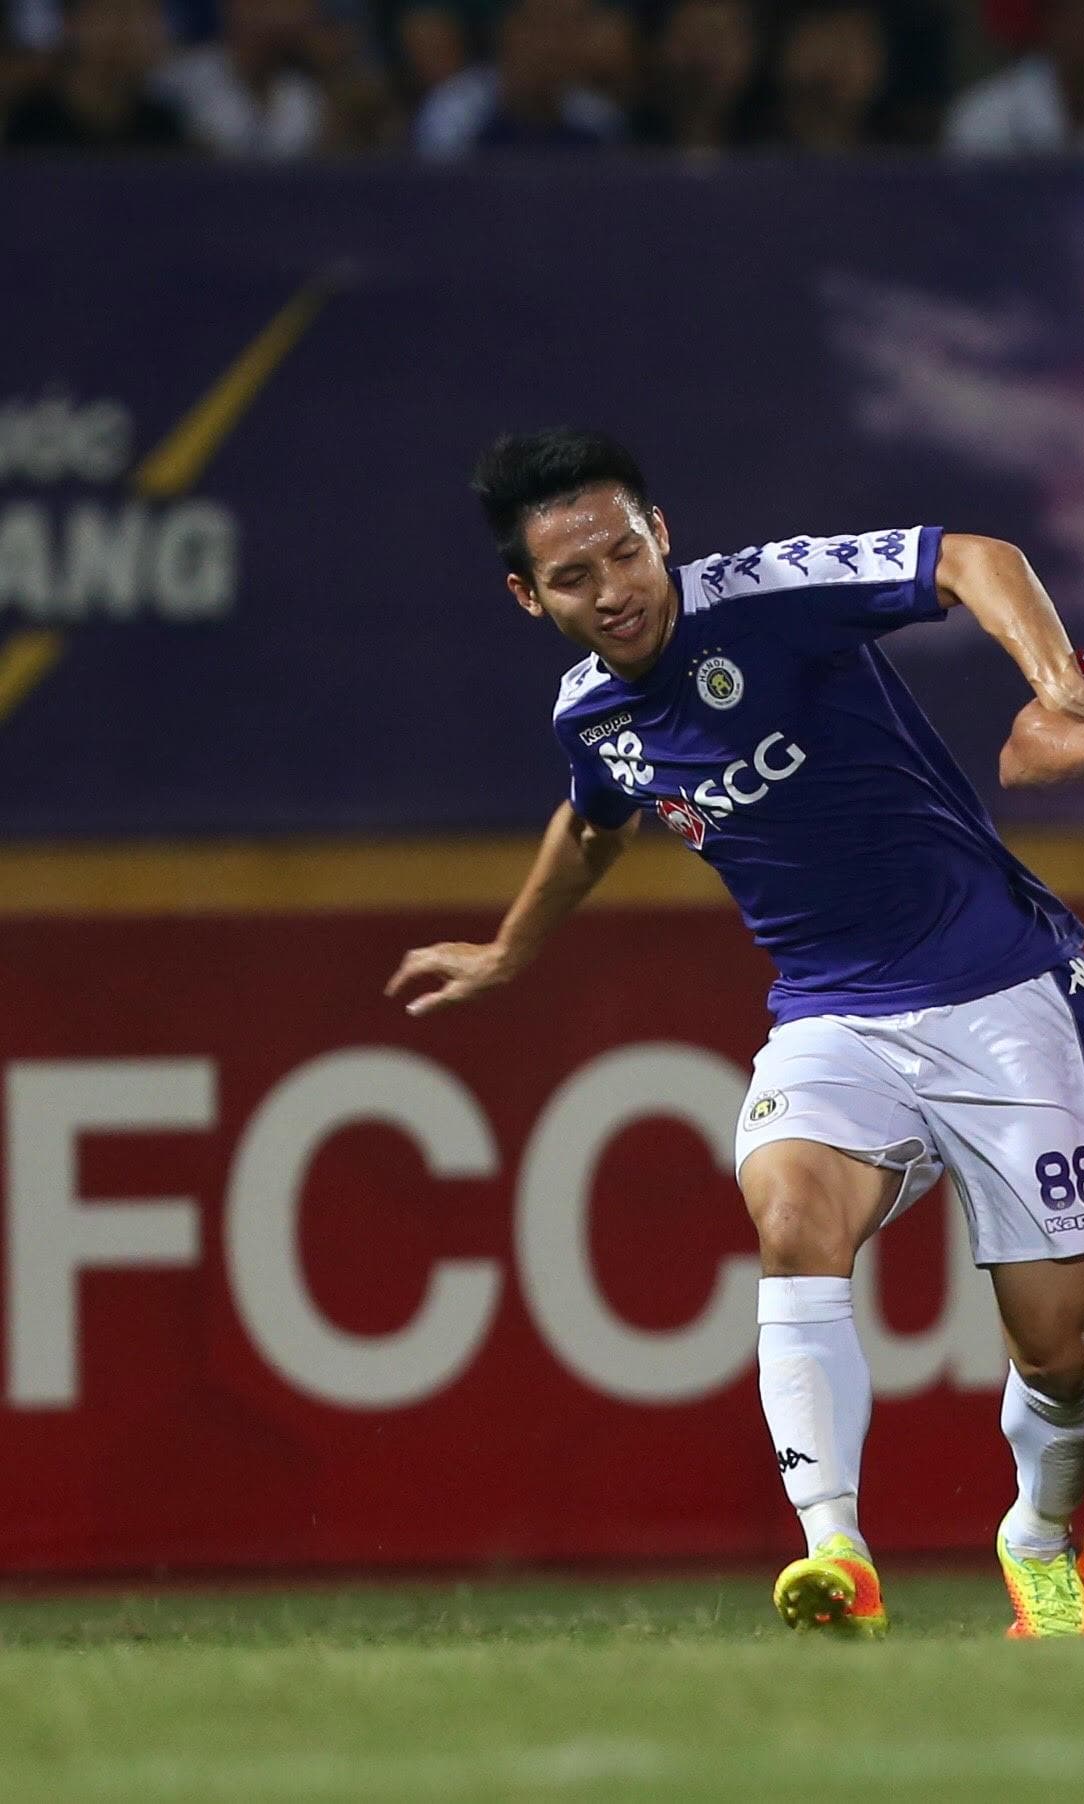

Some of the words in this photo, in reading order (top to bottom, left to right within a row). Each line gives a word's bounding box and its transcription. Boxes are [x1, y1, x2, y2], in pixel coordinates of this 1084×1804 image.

[699, 659, 724, 682] HANOI
[579, 713, 632, 746] Kappa
[694, 731, 807, 818] SCG
